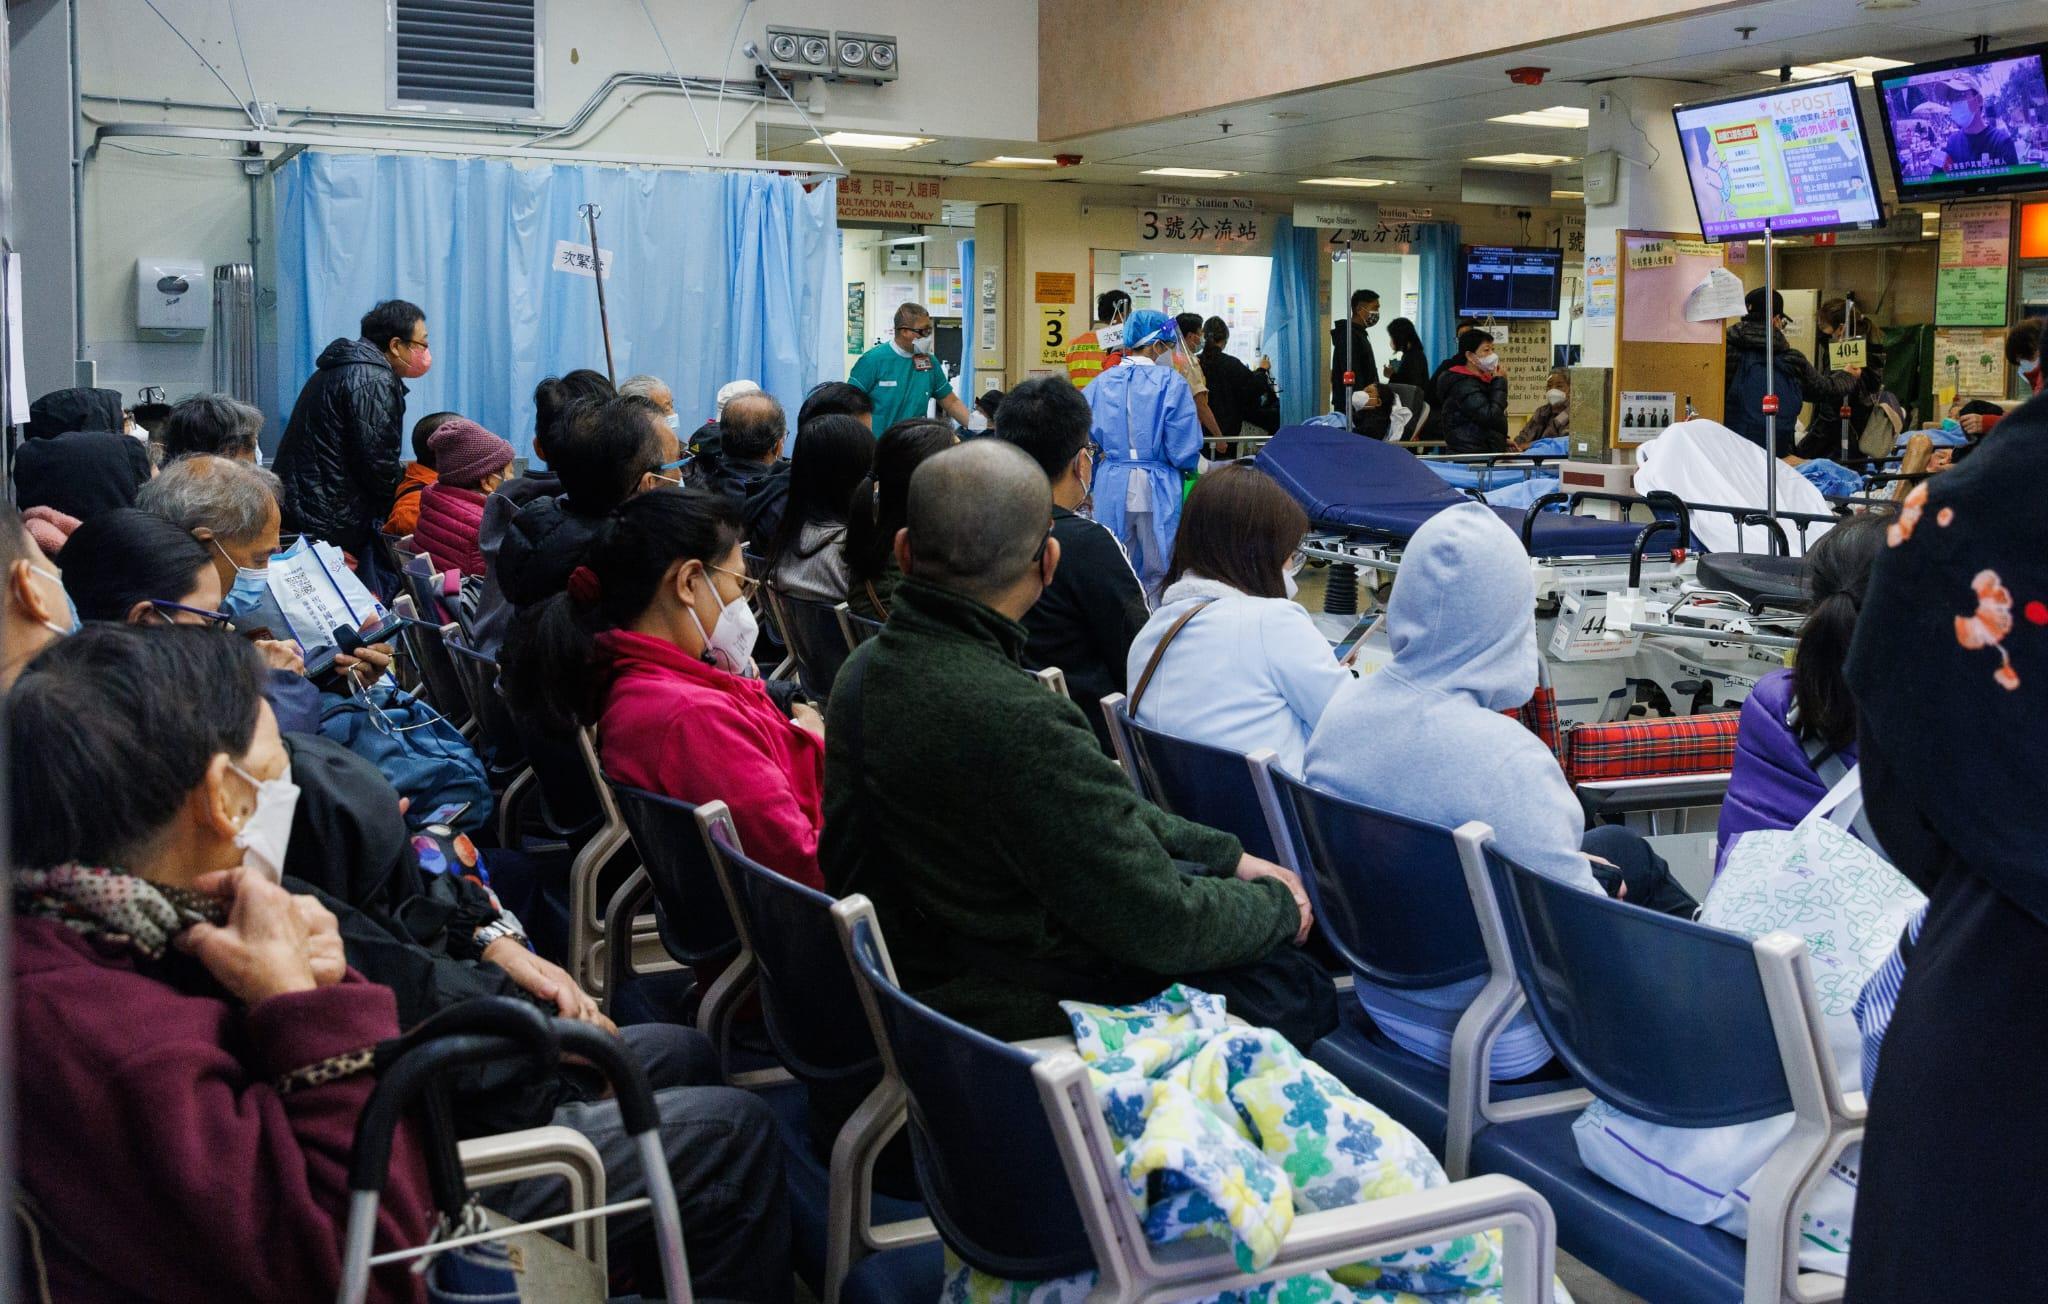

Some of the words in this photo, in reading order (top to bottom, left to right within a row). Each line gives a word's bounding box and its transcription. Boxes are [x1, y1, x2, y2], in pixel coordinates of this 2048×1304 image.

[1774, 92, 1833, 114] K-POST
[889, 200, 914, 209] AREA
[1162, 194, 1190, 207] Triage
[1196, 199, 1228, 209] Station
[1231, 199, 1253, 210] No.3
[838, 207, 907, 218] ACCOMPANIAN
[910, 210, 934, 220] ONLY
[1046, 319, 1063, 347] 3
[1836, 342, 1859, 358] 404
[1581, 615, 1607, 634] 44
